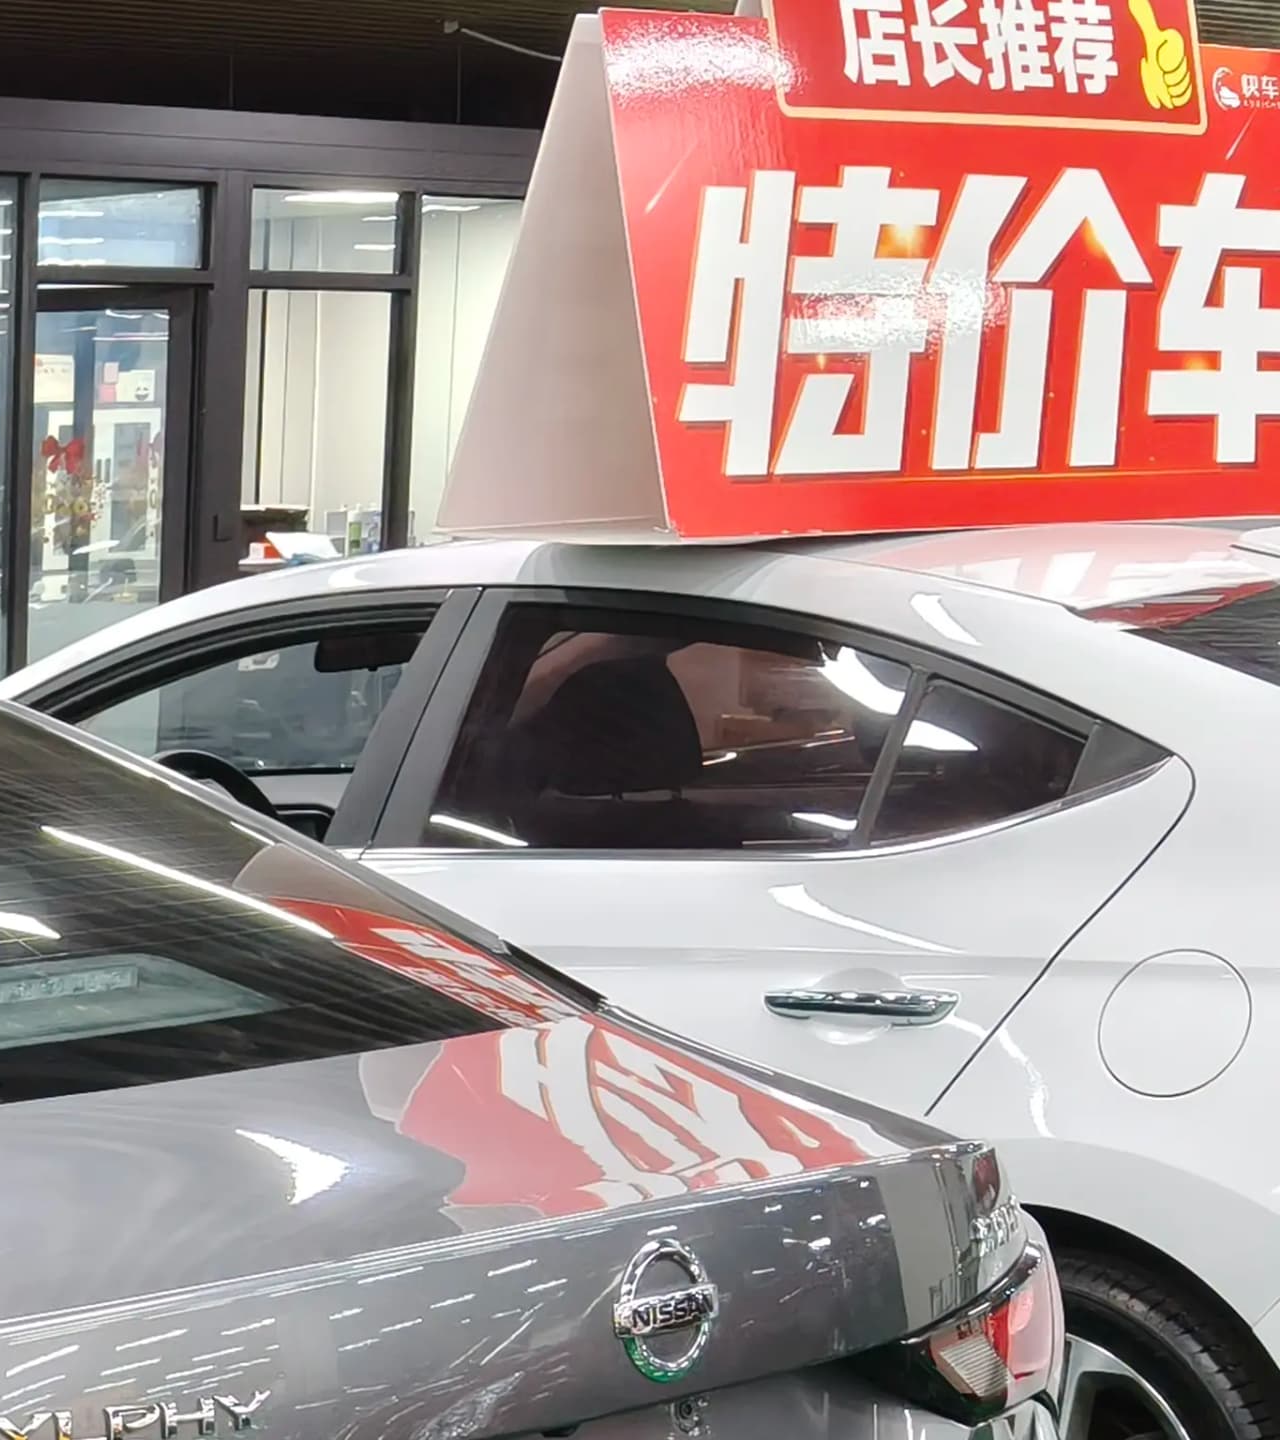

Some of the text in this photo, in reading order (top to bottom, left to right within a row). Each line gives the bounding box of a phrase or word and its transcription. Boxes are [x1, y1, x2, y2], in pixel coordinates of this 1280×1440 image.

[840, 0, 1118, 94] 店长推荐
[678, 165, 1280, 476] 特价车
[632, 1290, 714, 1328] NISSAN
